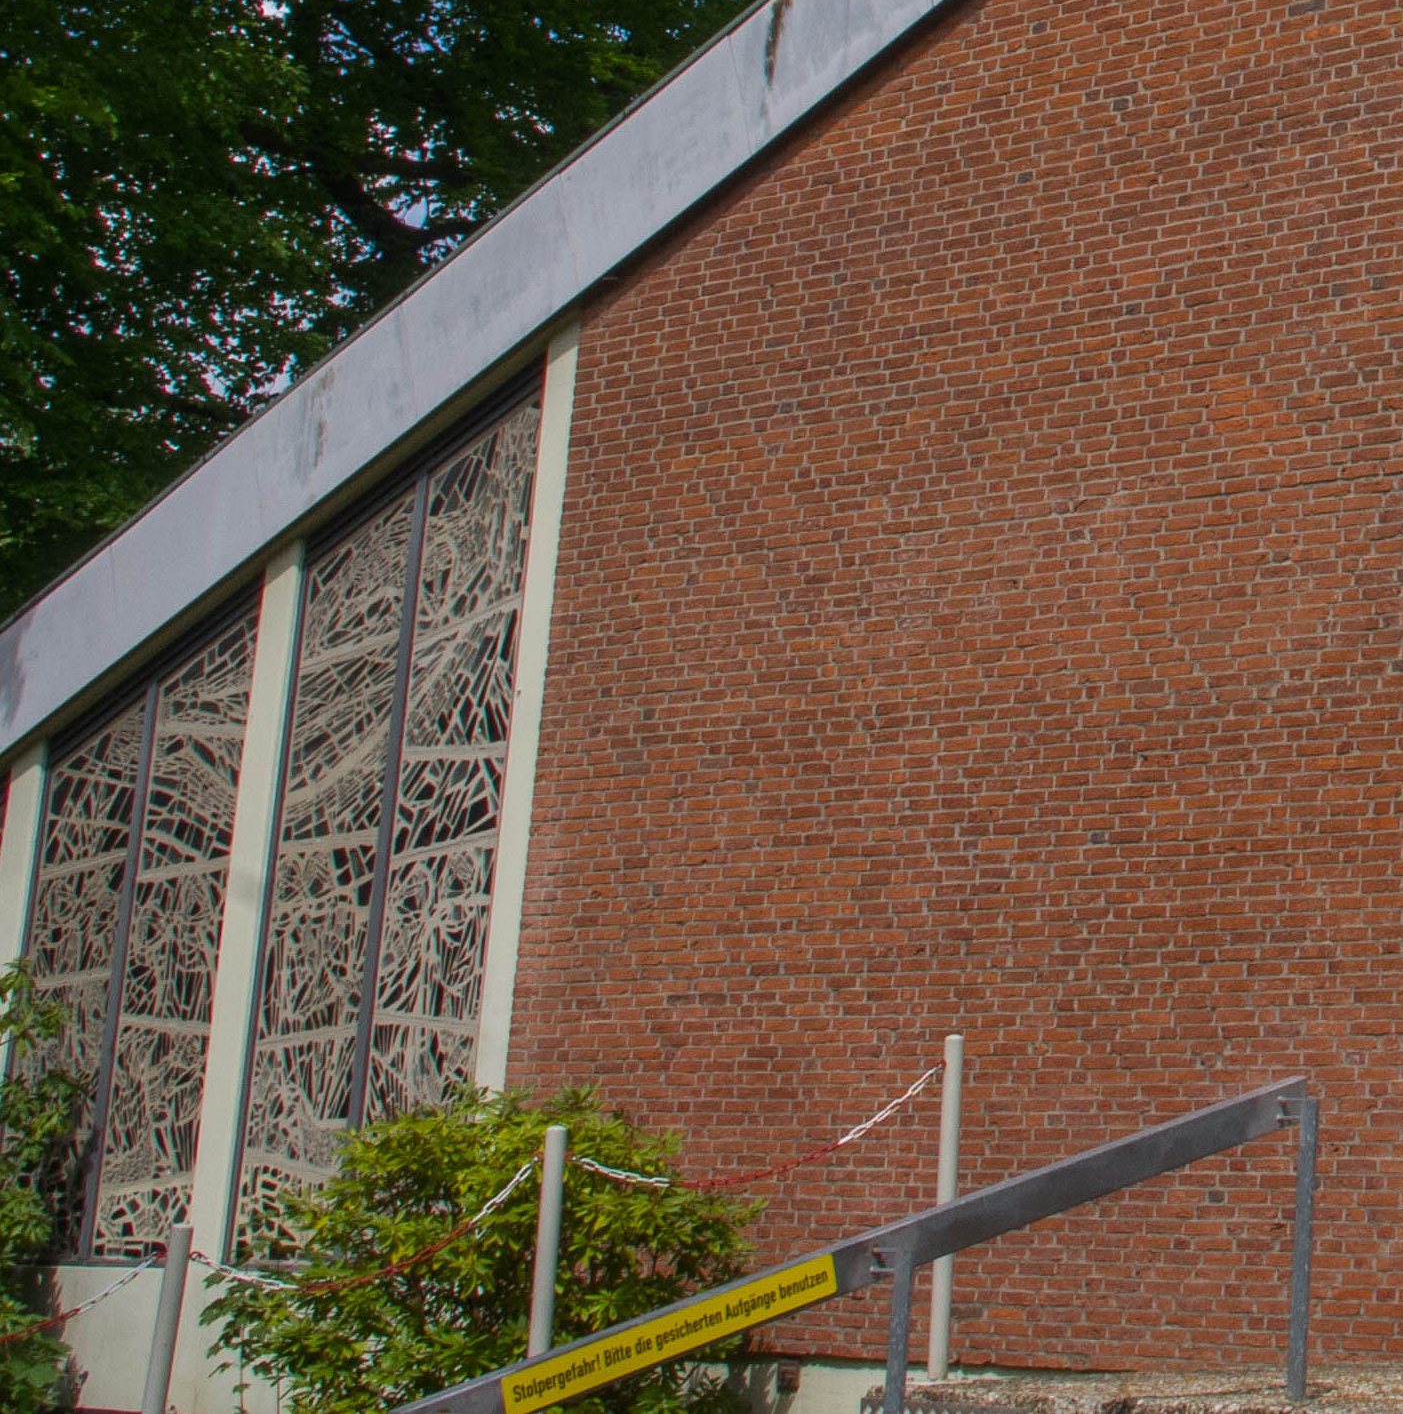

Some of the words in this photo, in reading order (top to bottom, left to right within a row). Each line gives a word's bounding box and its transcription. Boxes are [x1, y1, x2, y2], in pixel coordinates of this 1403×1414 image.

[512, 1354, 601, 1403] Stolpergefahr!
[603, 1345, 632, 1367] Bitte
[635, 1337, 653, 1355] die
[655, 1310, 723, 1351] gesicherten
[725, 1291, 777, 1321] Aufgänge
[778, 1270, 828, 1299] benutzen
